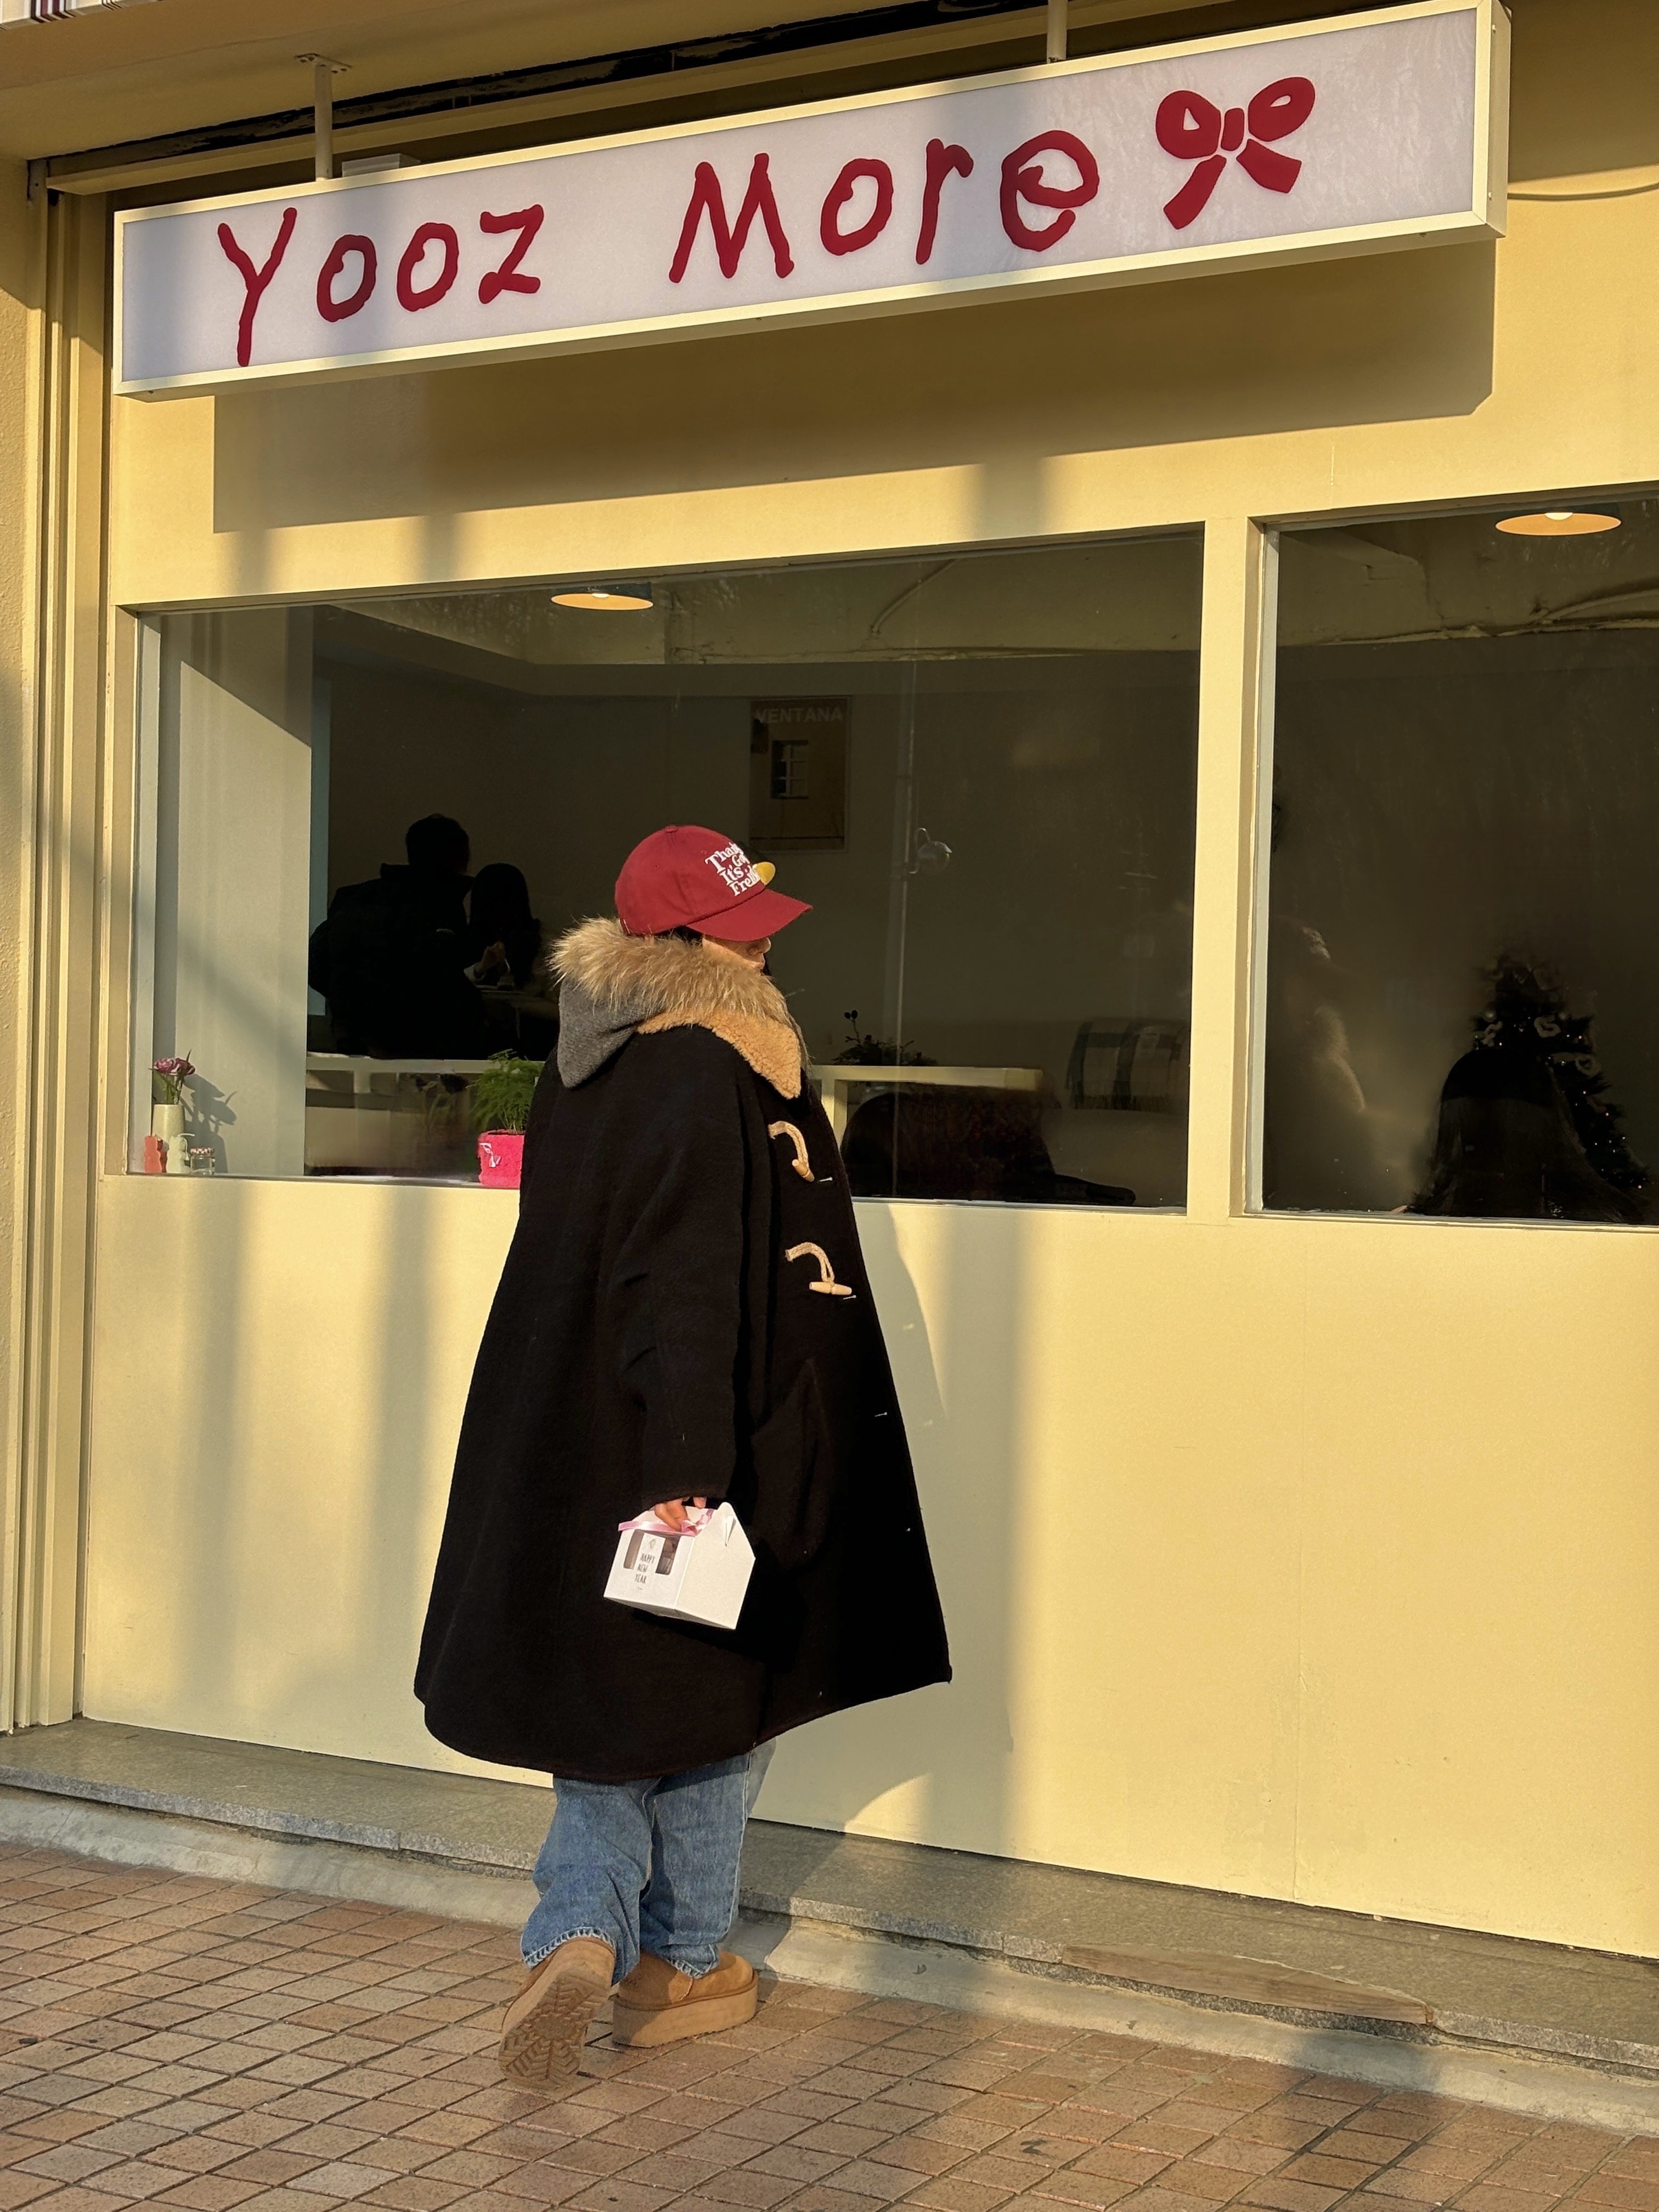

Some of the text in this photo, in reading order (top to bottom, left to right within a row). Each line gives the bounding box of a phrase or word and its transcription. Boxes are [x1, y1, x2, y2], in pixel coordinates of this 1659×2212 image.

[217, 138, 1100, 367] Yooz More
[755, 706, 843, 724] VENTANA
[720, 865, 744, 886] It's
[640, 1553, 656, 1564] HAPPY
[637, 1564, 648, 1573] NEW
[635, 1573, 647, 1584] YEAR
